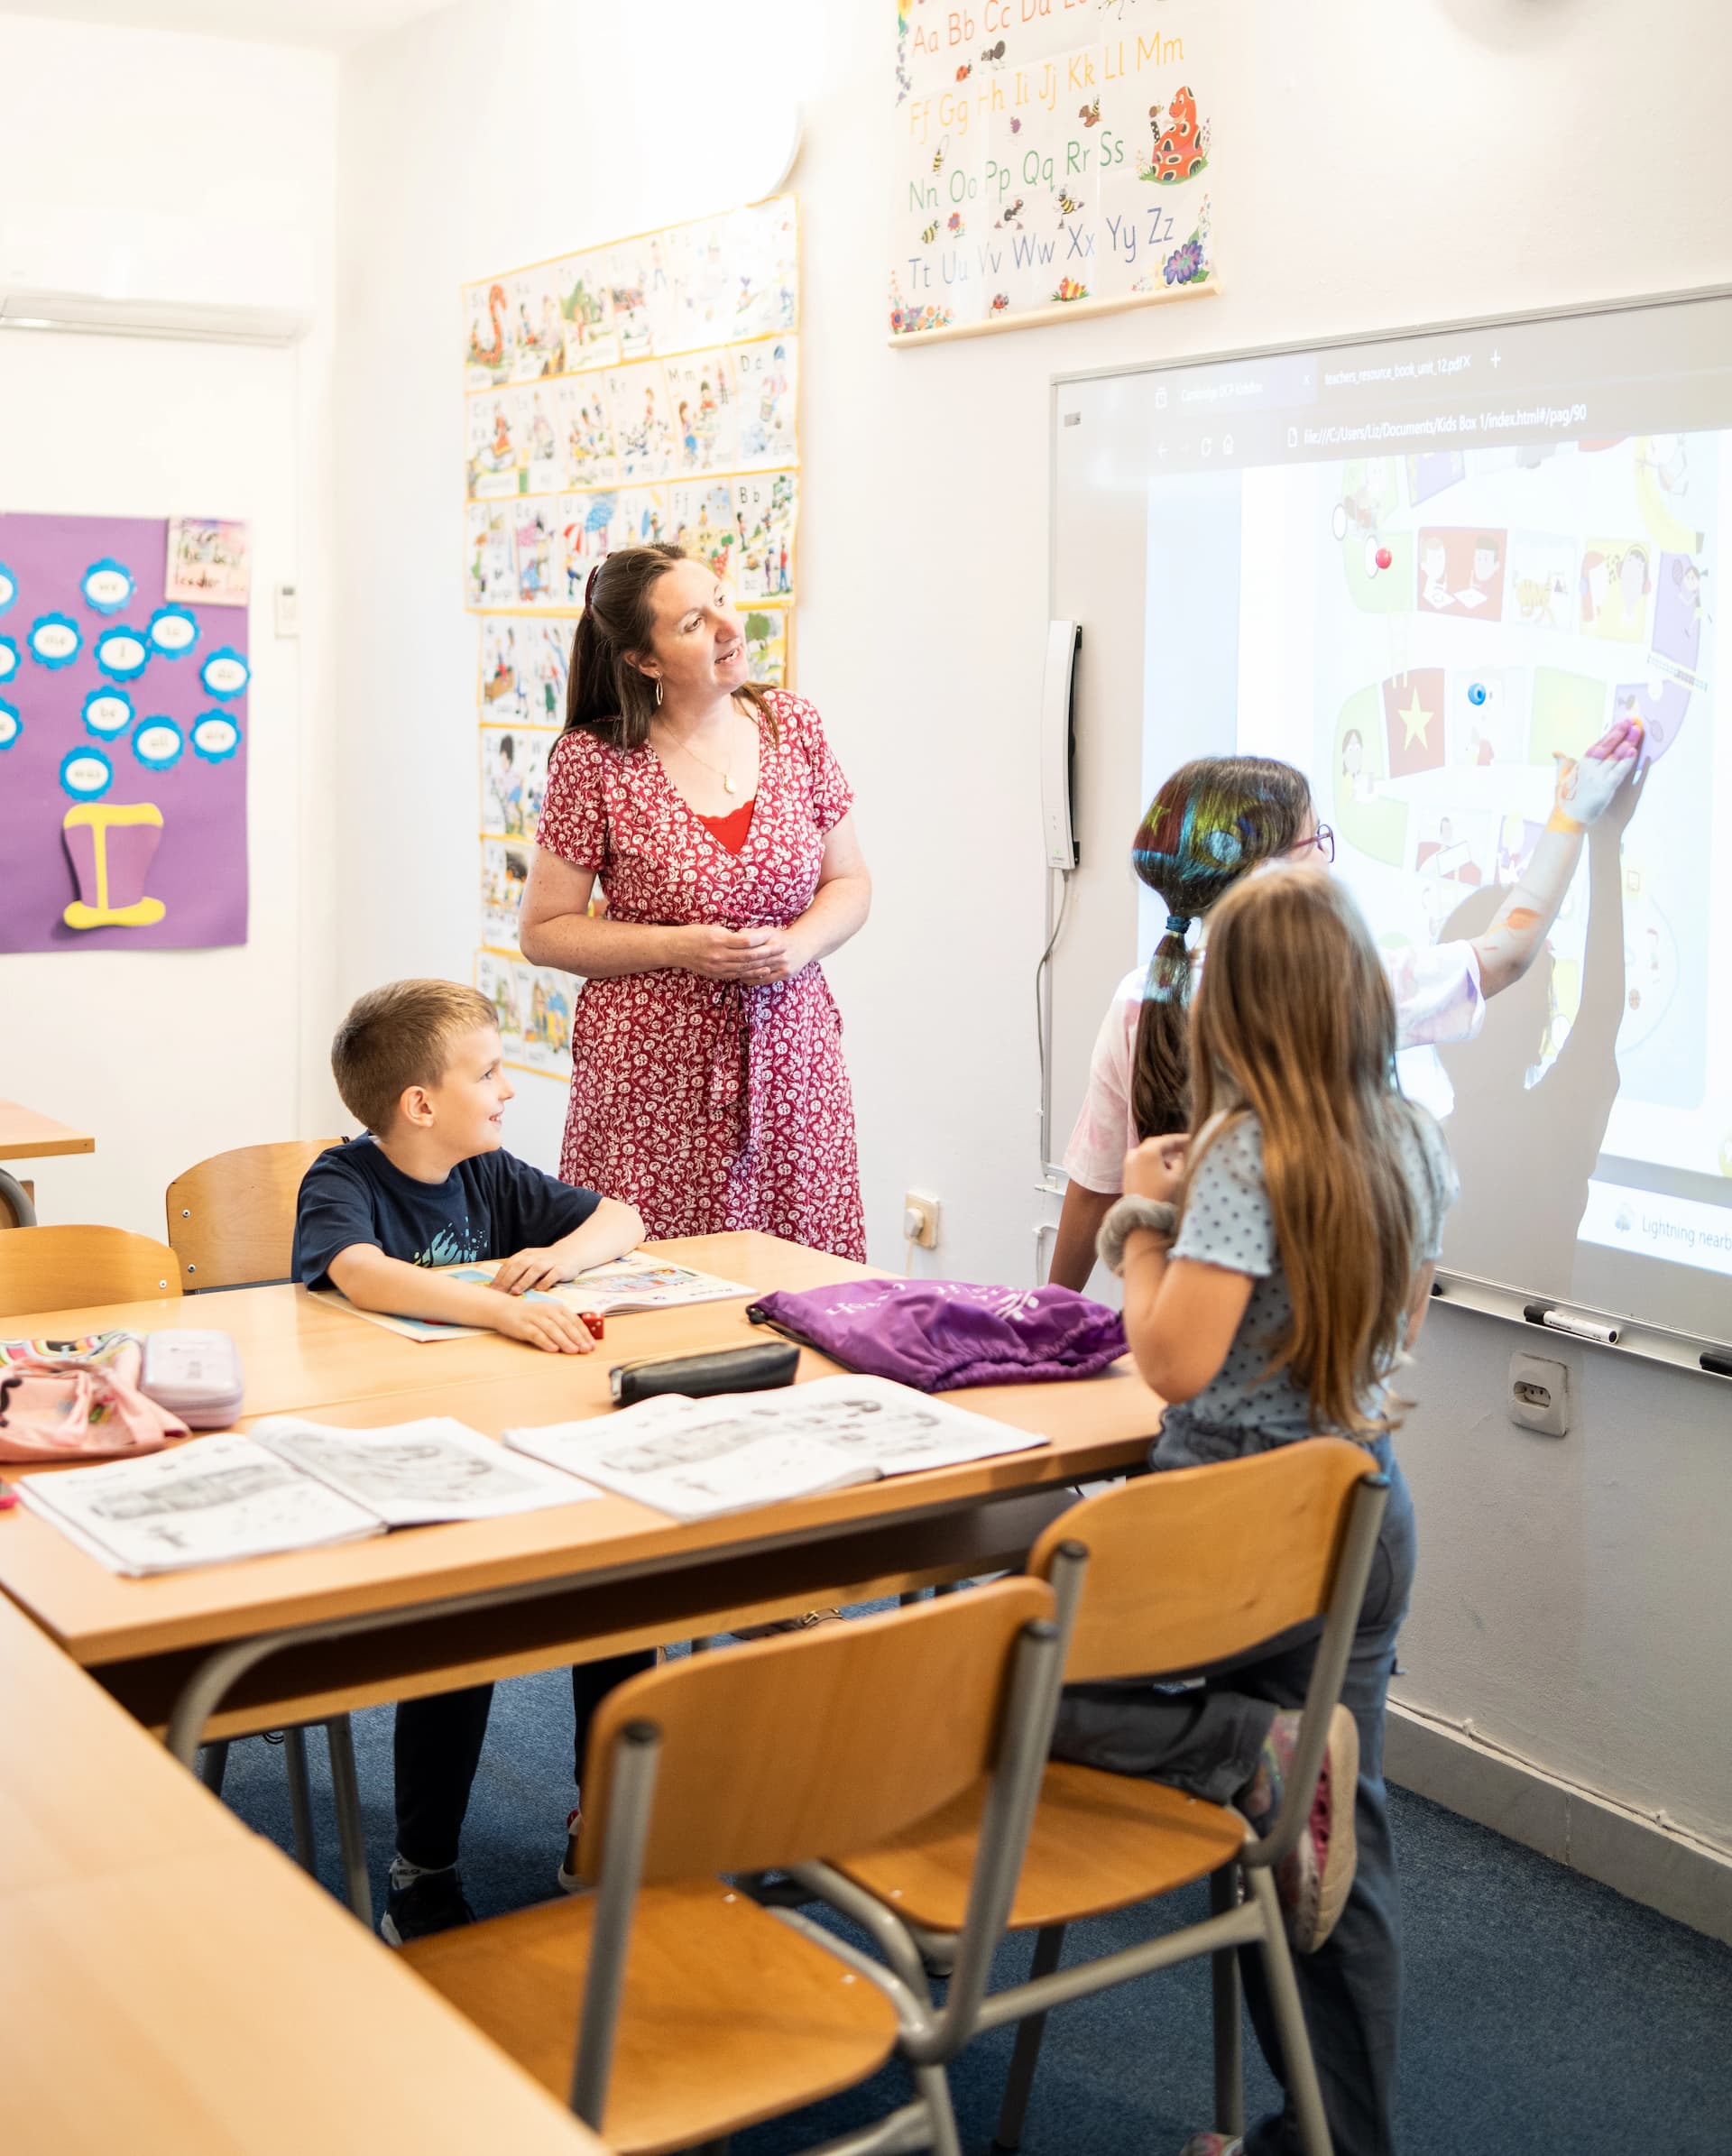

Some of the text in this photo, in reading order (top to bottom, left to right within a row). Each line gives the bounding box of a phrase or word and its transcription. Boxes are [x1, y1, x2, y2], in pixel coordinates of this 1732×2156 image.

[912, 24, 939, 57] Aa
[948, 9, 975, 46] Bb
[984, 0, 1011, 32] Cc
[909, 101, 930, 145] Ff
[939, 93, 969, 135] Gg
[1015, 71, 1030, 106] Ii
[1038, 63, 1057, 112] Jj
[1068, 53, 1096, 91] Kk
[1104, 41, 1125, 80] Ll
[1137, 31, 1184, 72] Mm
[909, 131, 1125, 212] Nn Oo Pp Qq Rr Ss
[908, 207, 1175, 290] Tt Uu Vv Ww Xx Yy Zz
[1459, 414, 1477, 431] Box
[1642, 1213, 1696, 1248] Lightning
